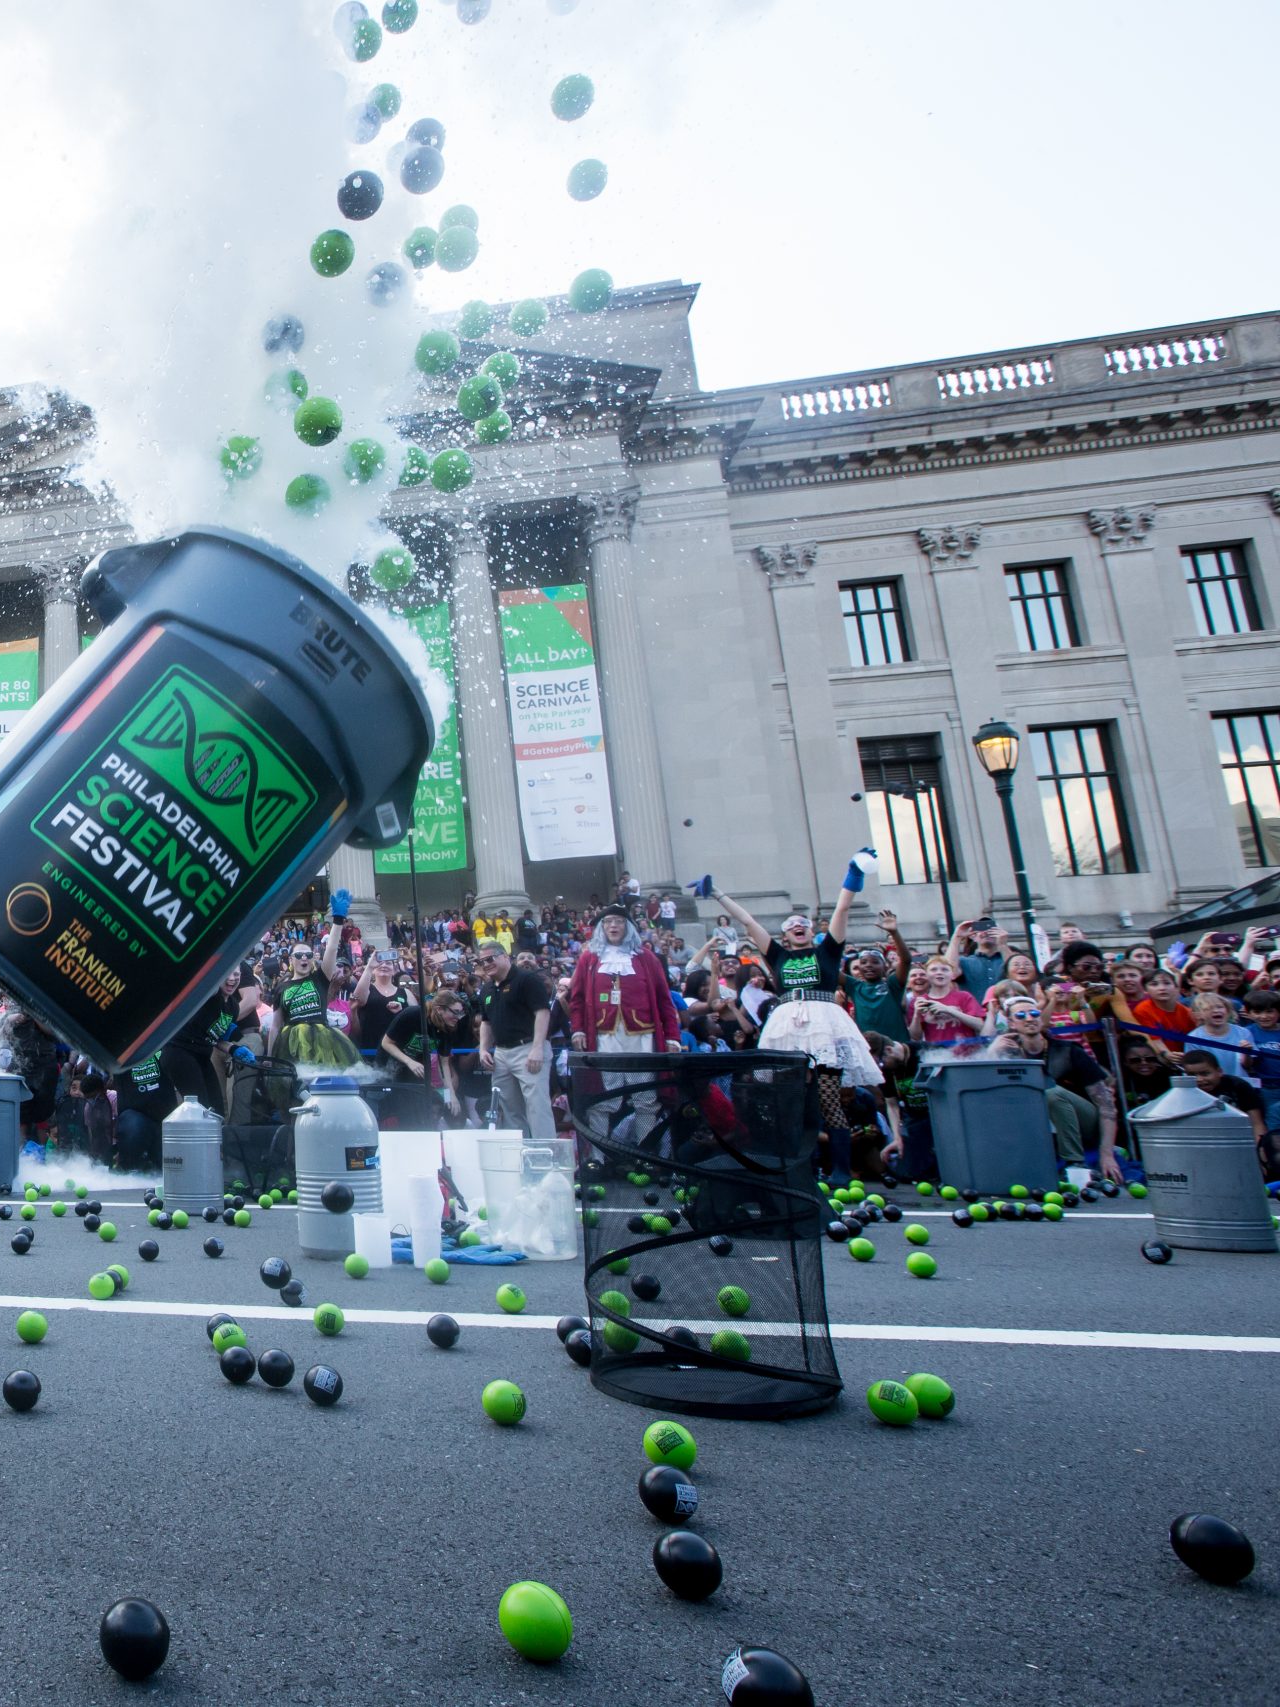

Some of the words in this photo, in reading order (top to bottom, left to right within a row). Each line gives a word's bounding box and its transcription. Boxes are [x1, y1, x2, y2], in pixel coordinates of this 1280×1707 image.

[288, 602, 372, 687] BRUTE
[514, 651, 544, 664] ALL
[13, 680, 31, 690] 80
[516, 678, 590, 697] SCIENCE
[517, 693, 591, 710] CARNIVAL
[533, 711, 549, 719] the
[551, 706, 592, 719] Parkway
[528, 722, 566, 733] APRIL
[570, 718, 586, 729] 23
[522, 741, 595, 756] #GetNerdyPHL
[101, 752, 242, 888] PHILADELPHIA
[76, 774, 226, 918] SCIENCE
[381, 849, 459, 863] ASTRONOMY
[50, 801, 194, 945] FESTIVAL
[41, 860, 128, 944] ENGINEERED
[129, 938, 148, 959] BY
[67, 918, 93, 944] THE
[56, 929, 126, 998] FRANKLIN
[44, 942, 115, 1011] INSTITUTE
[784, 976, 818, 985] FESTIVAL
[290, 1002, 319, 1015] FESTIVAL
[134, 1071, 158, 1080] FESTIVAL
